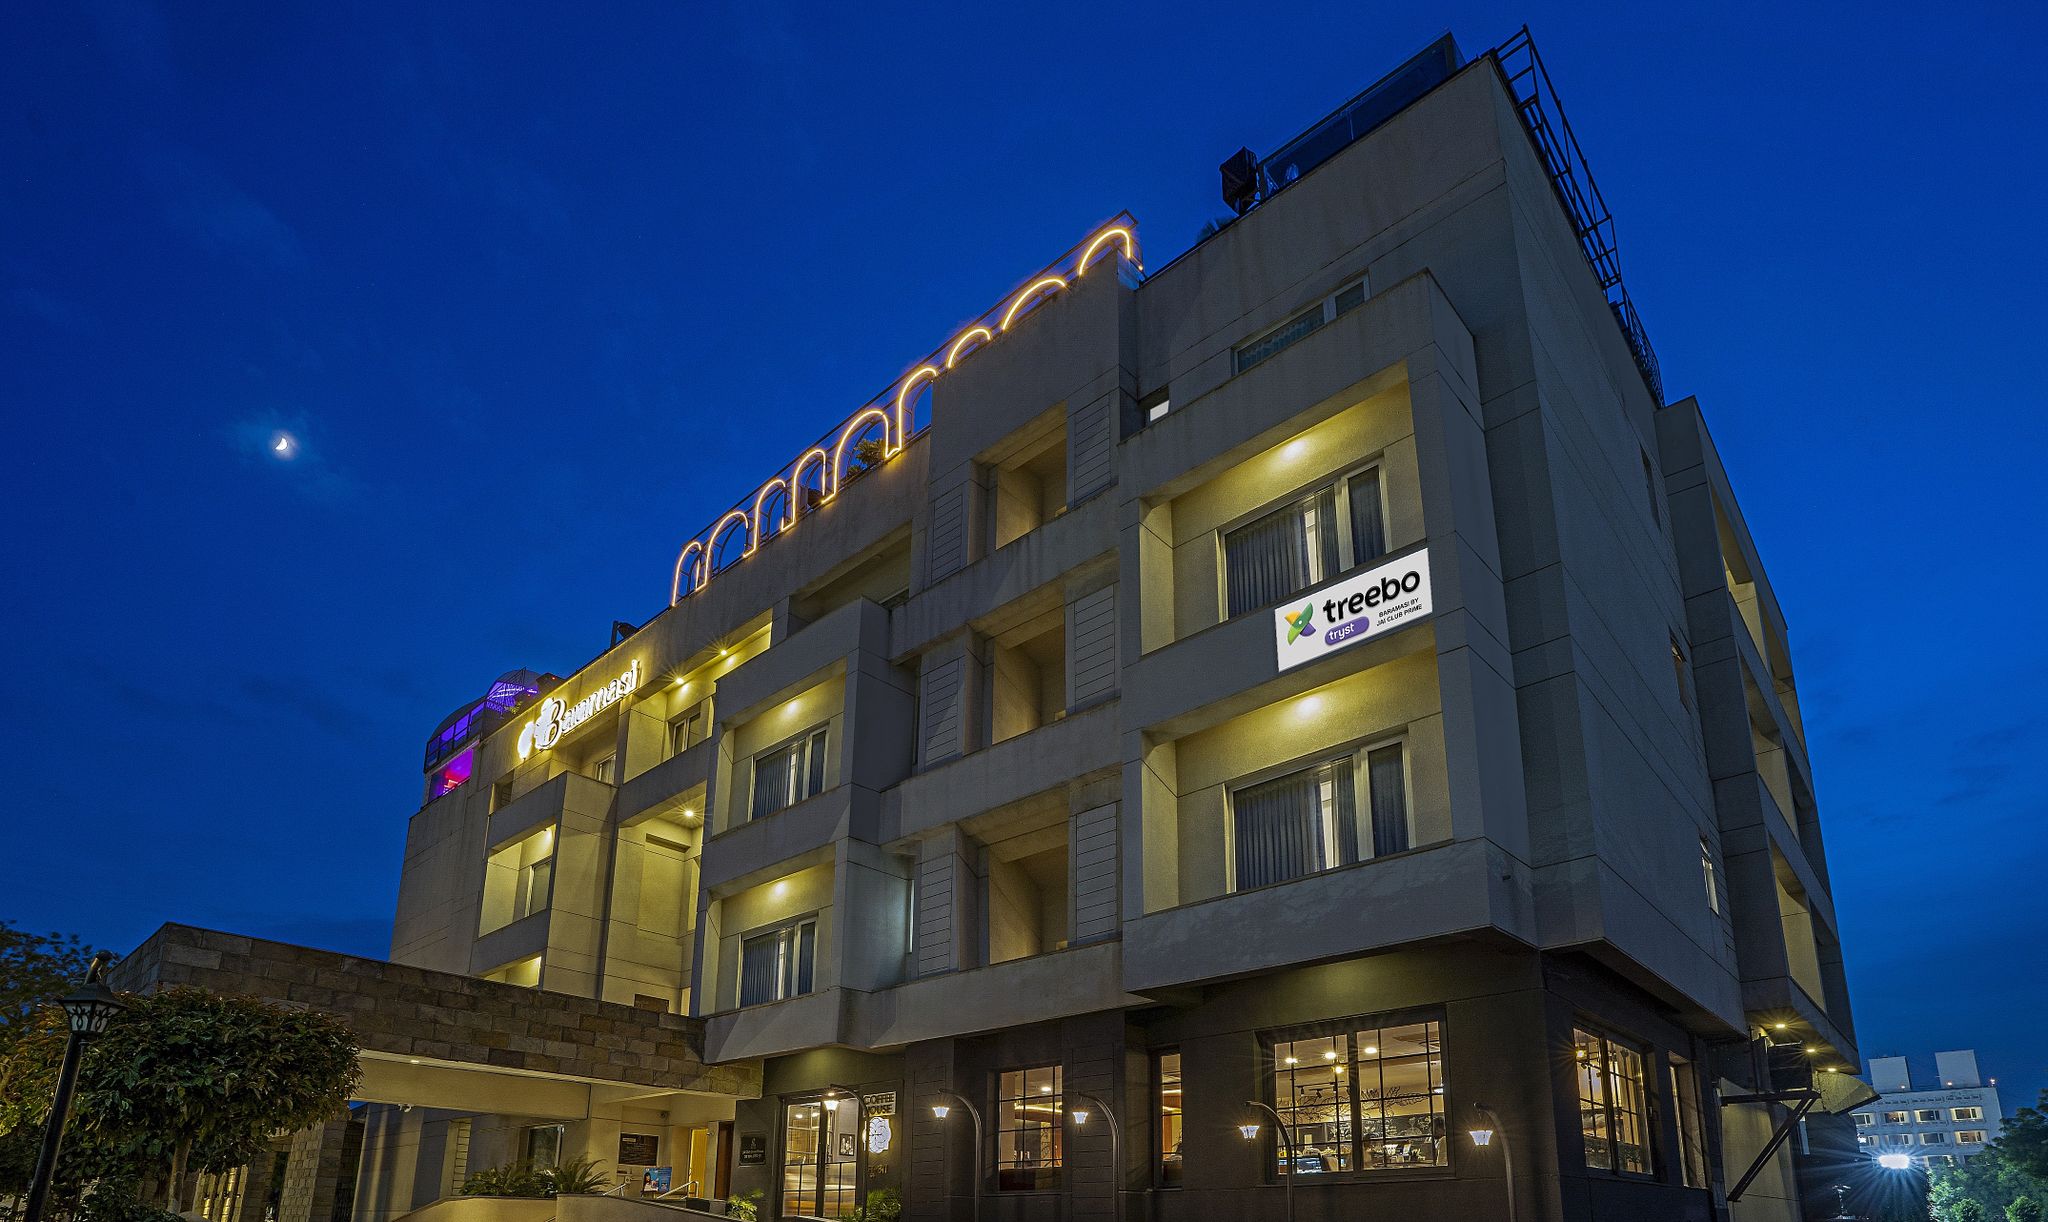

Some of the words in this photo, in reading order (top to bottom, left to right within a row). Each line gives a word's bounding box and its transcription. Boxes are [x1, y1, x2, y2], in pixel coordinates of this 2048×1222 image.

[1323, 571, 1420, 622] treebo
[1376, 618, 1386, 627] JAI
[1386, 611, 1403, 622] CLUB
[1404, 604, 1422, 615] PRIME
[1379, 602, 1409, 617] BARAMASI
[1328, 623, 1354, 640] tryst
[863, 1093, 895, 1105] COFFEE
